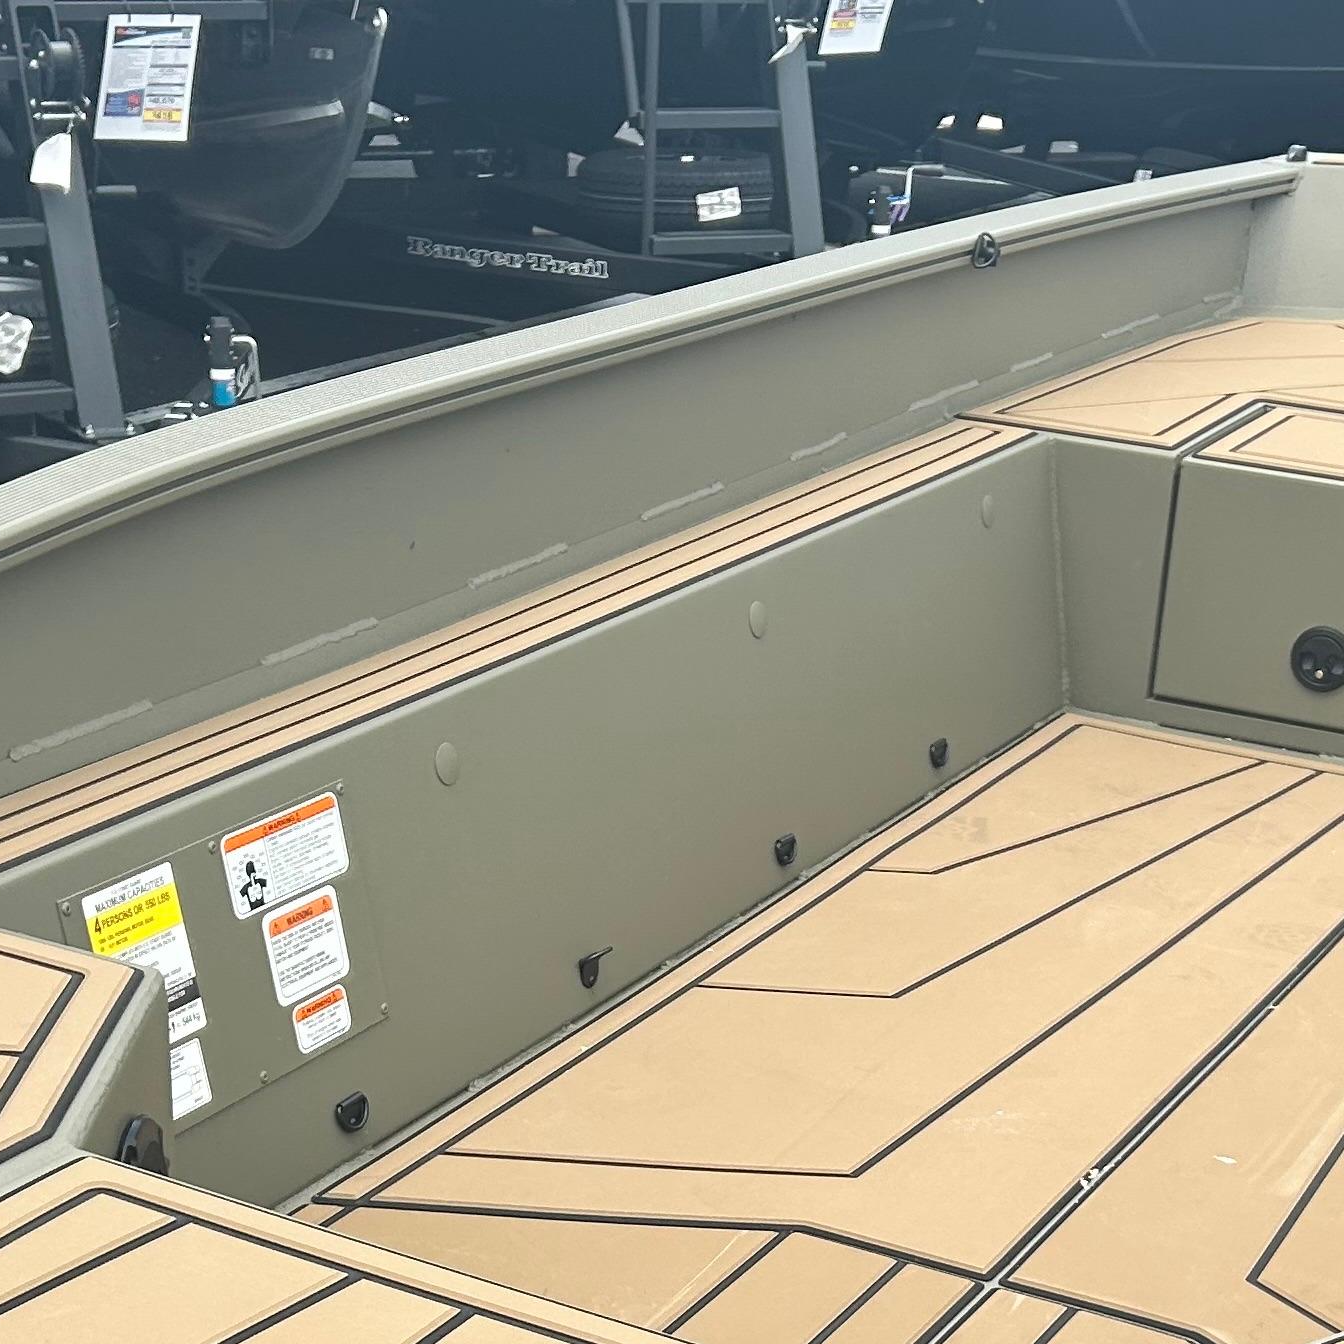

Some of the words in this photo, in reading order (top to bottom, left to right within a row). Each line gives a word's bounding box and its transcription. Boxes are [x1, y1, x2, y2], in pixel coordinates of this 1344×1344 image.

[406, 236, 525, 268] Ranger
[526, 252, 609, 279] Trail
[95, 917, 102, 935] 4
